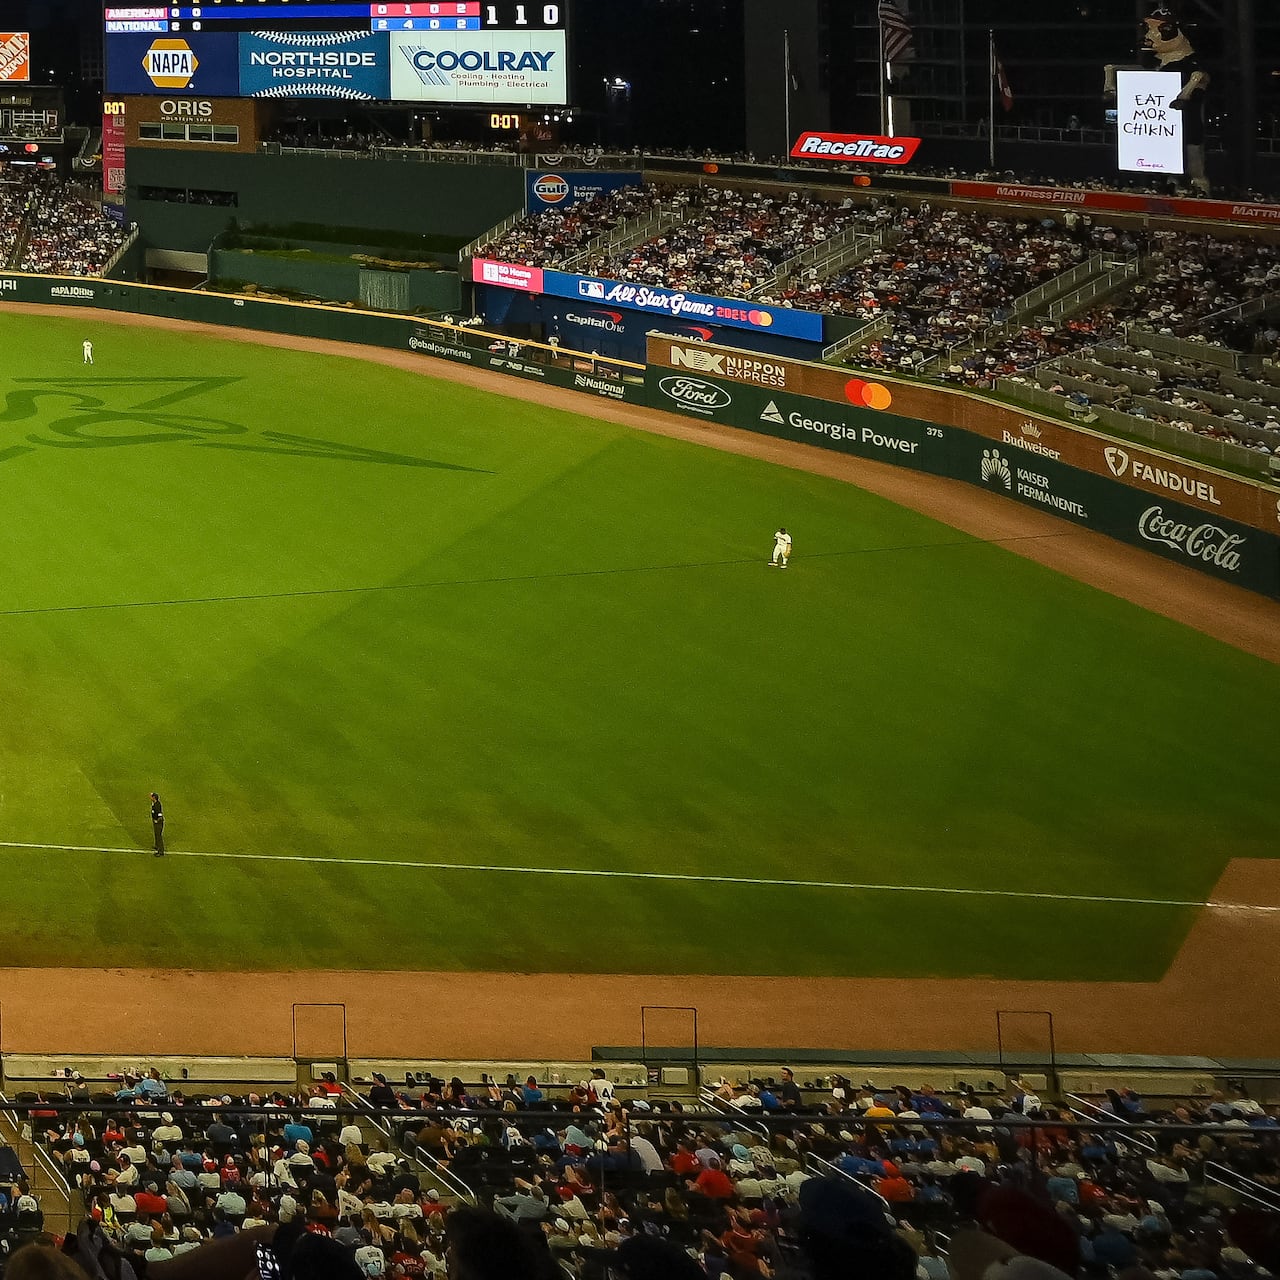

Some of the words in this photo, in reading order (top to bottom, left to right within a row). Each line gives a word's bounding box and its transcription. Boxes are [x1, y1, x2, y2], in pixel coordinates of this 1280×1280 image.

[108, 8, 164, 18] AMERICAN
[108, 21, 162, 31] NATIONAL
[0, 51, 30, 80] DEPOT
[152, 54, 189, 73] NAPA
[250, 52, 376, 66] NORTHSIDE
[413, 51, 556, 71] COOLRAY
[272, 68, 353, 78] HOSPITAL
[451, 73, 483, 81] Cooling
[491, 73, 525, 81] Heating
[459, 80, 499, 89] Plumbing
[160, 100, 212, 116] ORIS
[1135, 94, 1165, 107] EAT
[490, 114, 520, 129] 0:07
[1133, 108, 1166, 121] MOR
[1123, 123, 1175, 137] CHIKIN
[801, 137, 904, 159] RaceTrac
[536, 184, 568, 193] Gulf
[605, 284, 632, 302] All
[635, 287, 671, 309] Star
[670, 293, 714, 317] Game
[715, 307, 748, 321] 2025
[727, 357, 785, 377] NIPPON
[727, 367, 785, 387] EXPRESS
[585, 378, 625, 394] National
[671, 380, 718, 405] Ford
[789, 411, 856, 442] Georgia
[861, 427, 919, 455] Power
[926, 426, 943, 438] 375
[1002, 430, 1060, 460] Budweiser
[1017, 467, 1049, 490] KAISER
[1132, 461, 1221, 505] FANDUEL
[1017, 484, 1083, 517] PERMANENTE
[1139, 505, 1247, 571] Coca-Cola
